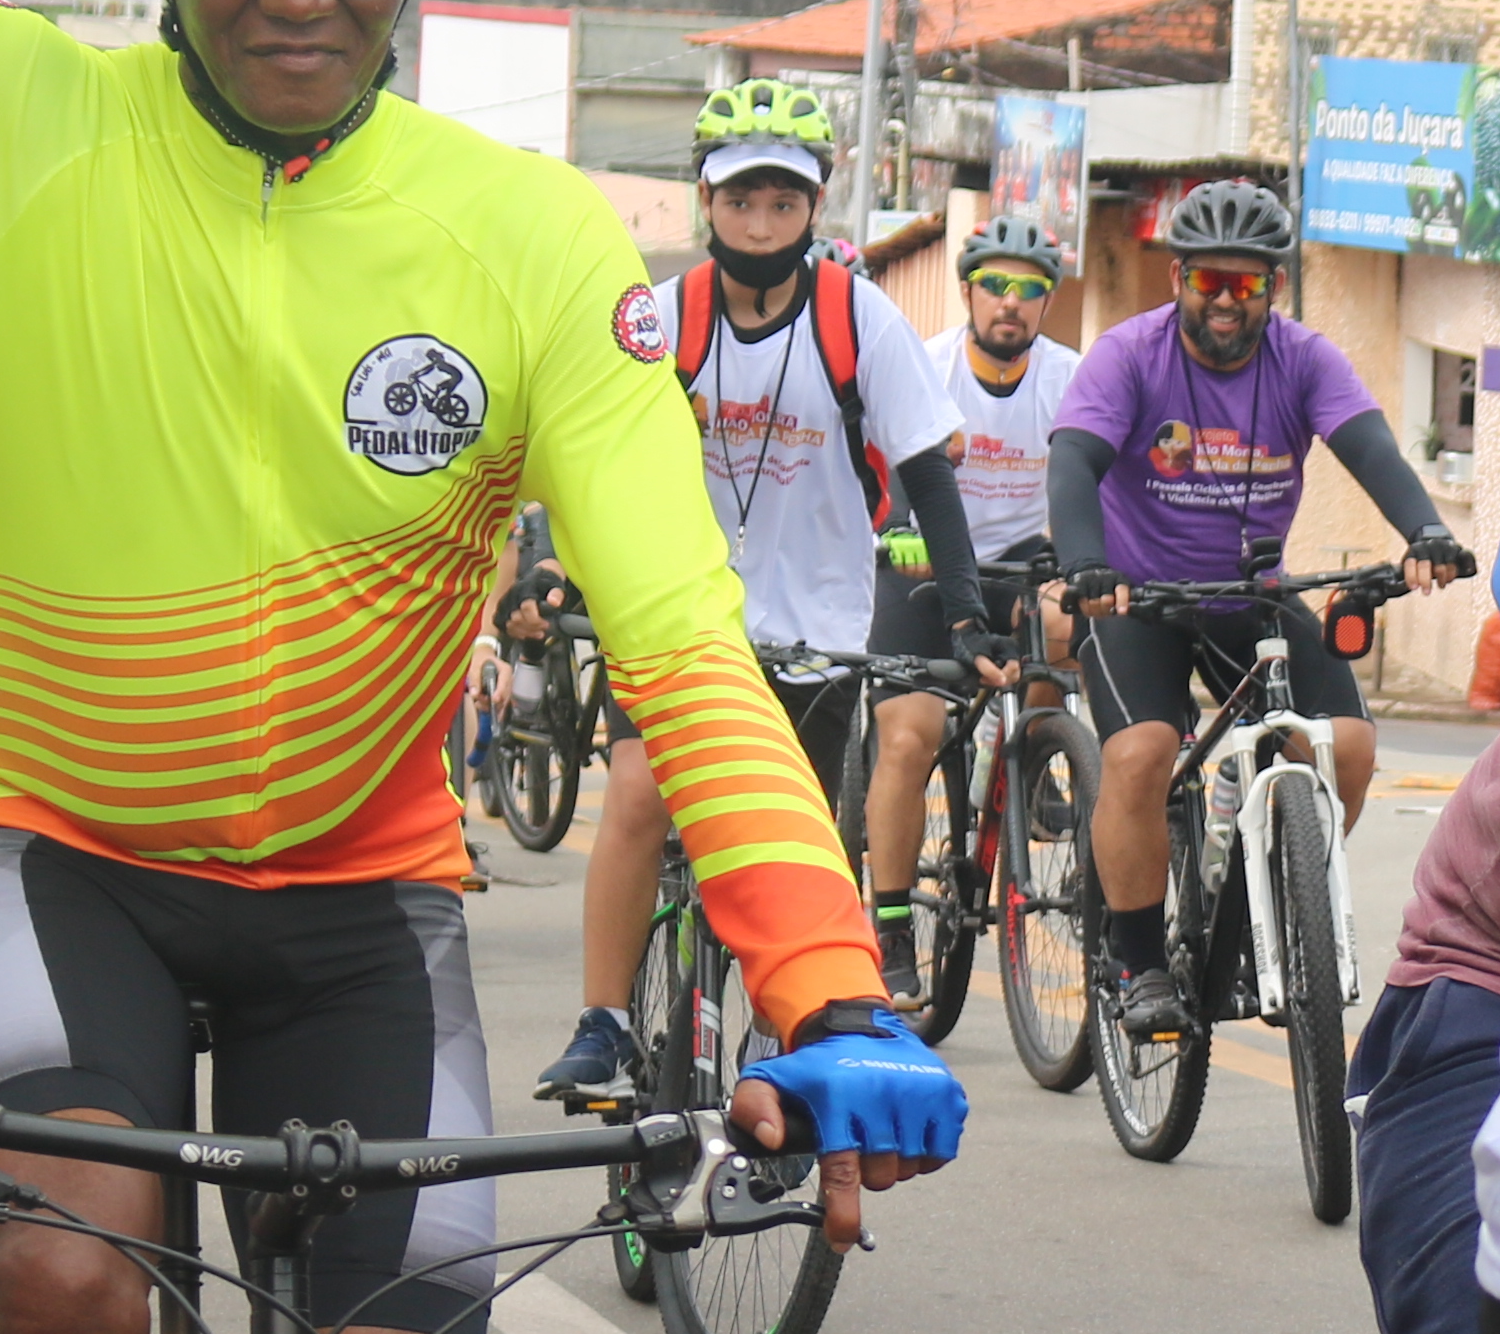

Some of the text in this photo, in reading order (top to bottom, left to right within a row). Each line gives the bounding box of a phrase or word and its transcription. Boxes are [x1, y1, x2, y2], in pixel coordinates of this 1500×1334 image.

[1316, 100, 1464, 154] Ponto da Juçara
[348, 426, 481, 455] PEDAL UTOPIA
[202, 1145, 244, 1167] WG
[419, 1154, 461, 1173] WG
